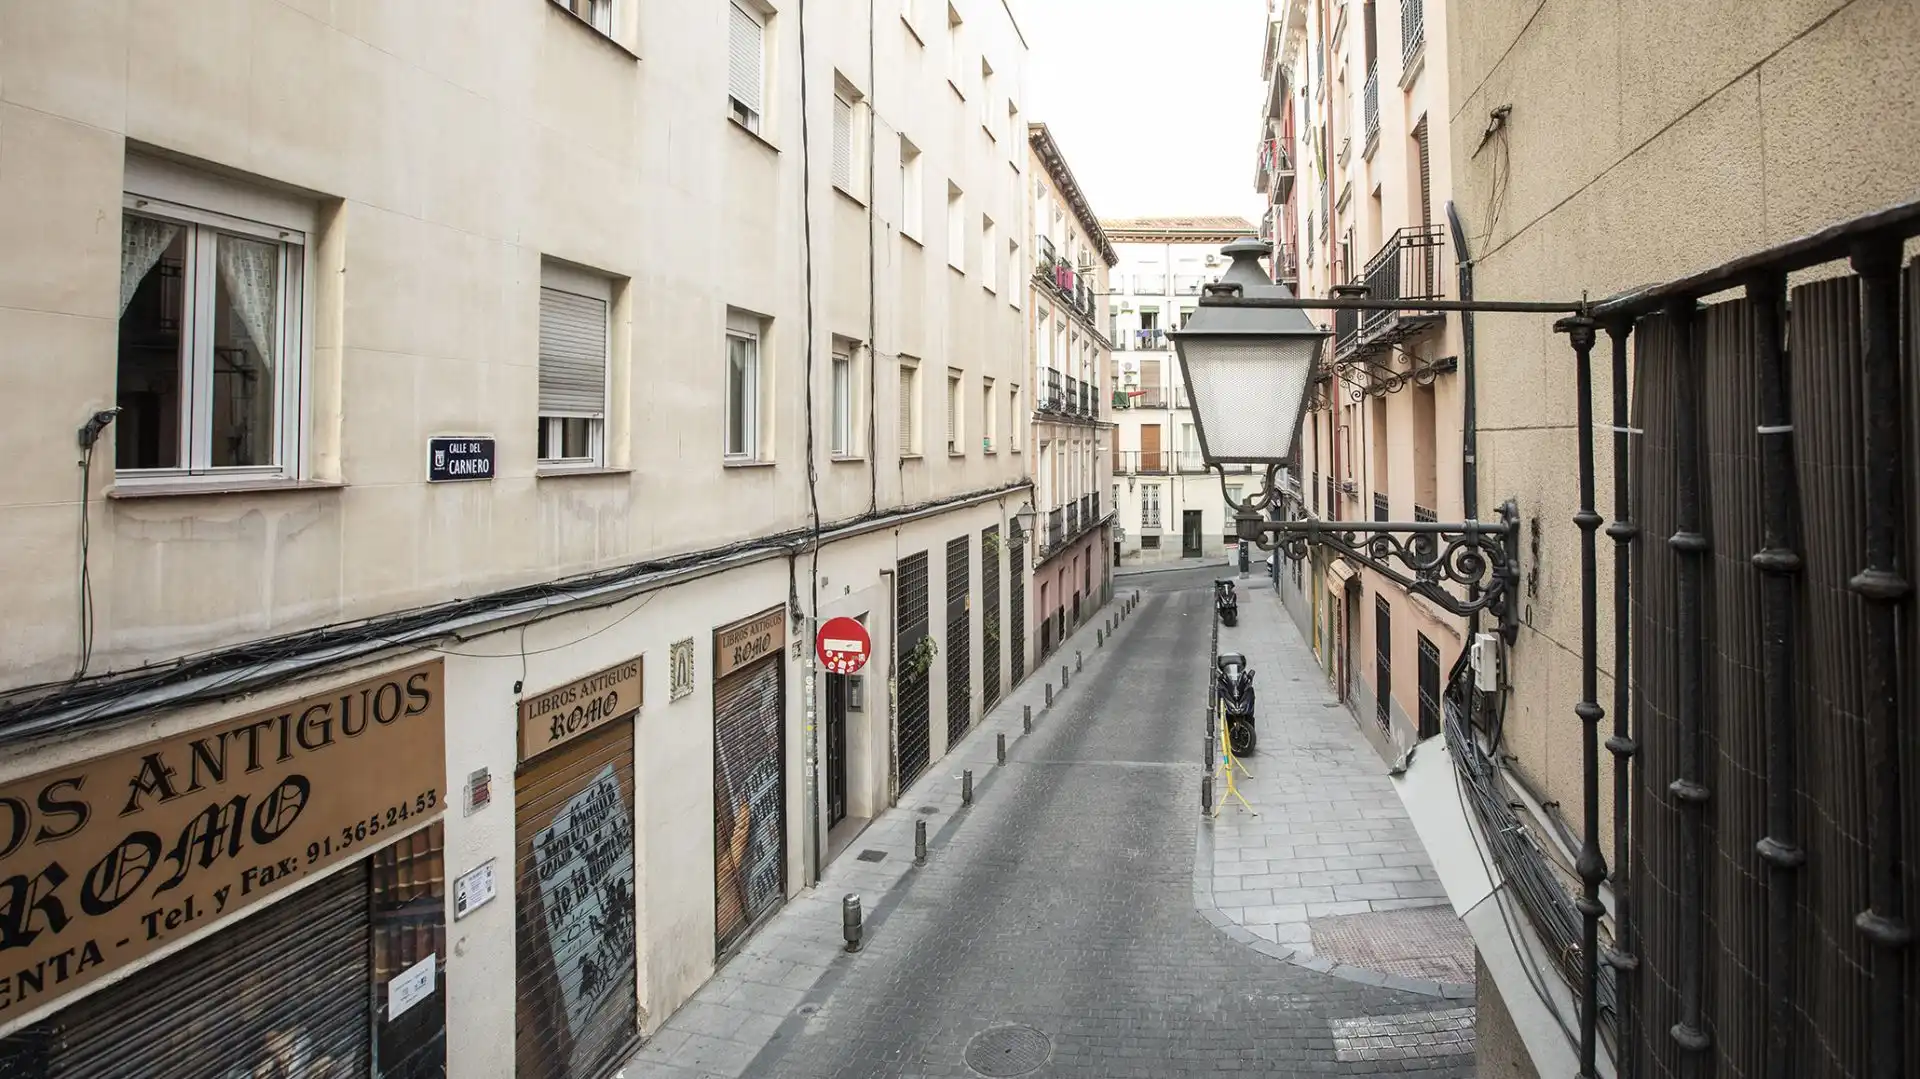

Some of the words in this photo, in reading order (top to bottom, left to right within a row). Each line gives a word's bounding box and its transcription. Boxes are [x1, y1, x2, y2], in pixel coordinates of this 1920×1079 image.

[449, 443, 467, 453] CALLE
[470, 443, 481, 453] DEL
[449, 458, 489, 474] CARNERO
[723, 628, 748, 648] LIBROS
[750, 614, 782, 636] ANTIGUOS
[733, 633, 771, 666] ROMO
[529, 687, 577, 720] LIBROS
[580, 663, 637, 698] ANTIGUOS
[548, 690, 618, 743] ROMO
[118, 672, 431, 818] ANTIGUOS
[0, 775, 310, 948] ROMO
[141, 899, 203, 941] Tel.
[214, 884, 230, 913] y
[241, 854, 298, 896] Fax:
[306, 789, 437, 866] 91.365.24.53
